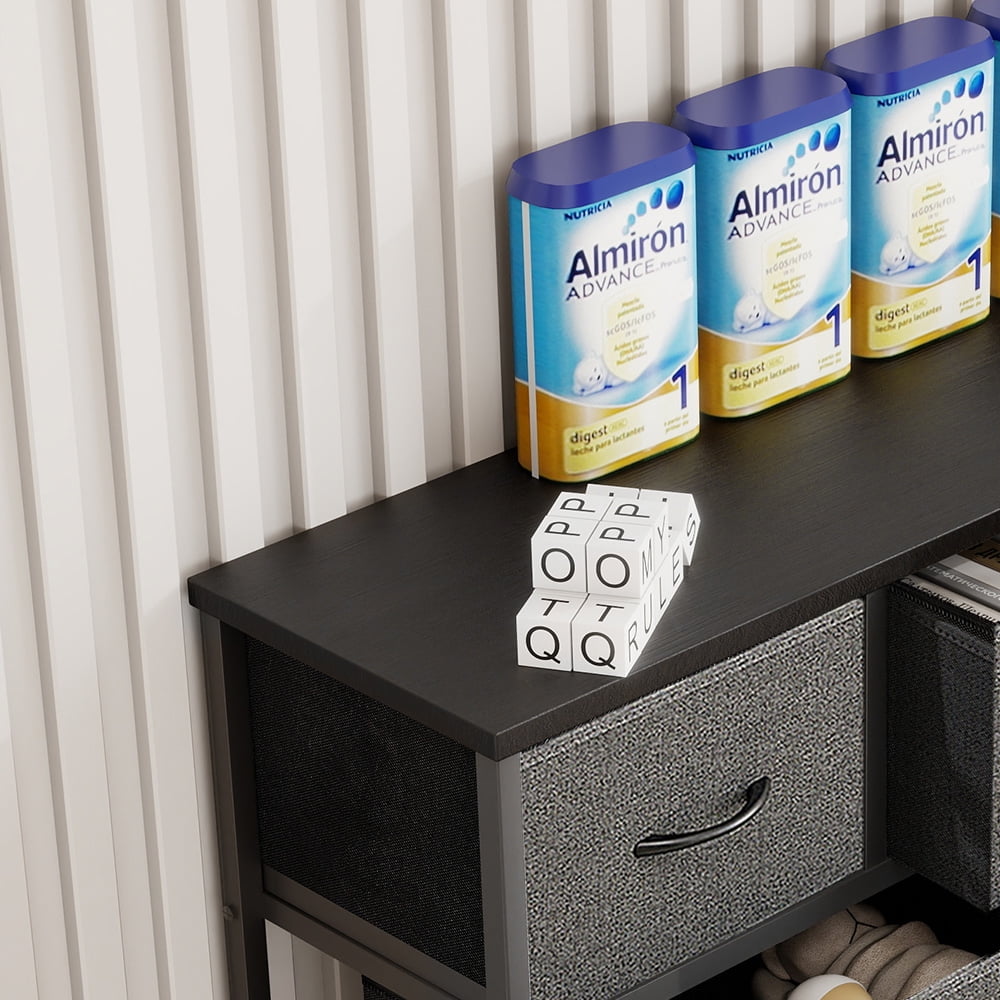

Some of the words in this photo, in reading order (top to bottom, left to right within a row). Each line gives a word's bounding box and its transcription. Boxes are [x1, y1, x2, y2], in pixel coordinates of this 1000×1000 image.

[877, 89, 921, 108] NUTRICIA
[727, 141, 773, 162] NUTRICIA
[877, 109, 984, 168] Almirón
[875, 145, 957, 185] ADVANCE
[564, 200, 612, 221] NUTRICIA
[728, 162, 841, 224] Almirón
[727, 199, 813, 240] ADVANCE
[566, 220, 687, 284] Almirón
[967, 247, 981, 291] 1
[565, 258, 655, 301] ADVANCE
[826, 303, 840, 347] 1
[875, 304, 909, 322] digest
[672, 364, 687, 410] 1
[729, 362, 765, 381] digest
[570, 425, 607, 445] digest
[541, 548, 575, 582] O
[596, 554, 630, 588] O
[541, 598, 569, 616] T
[596, 604, 624, 622] T
[526, 626, 560, 664] Q
[581, 632, 615, 670] Q
